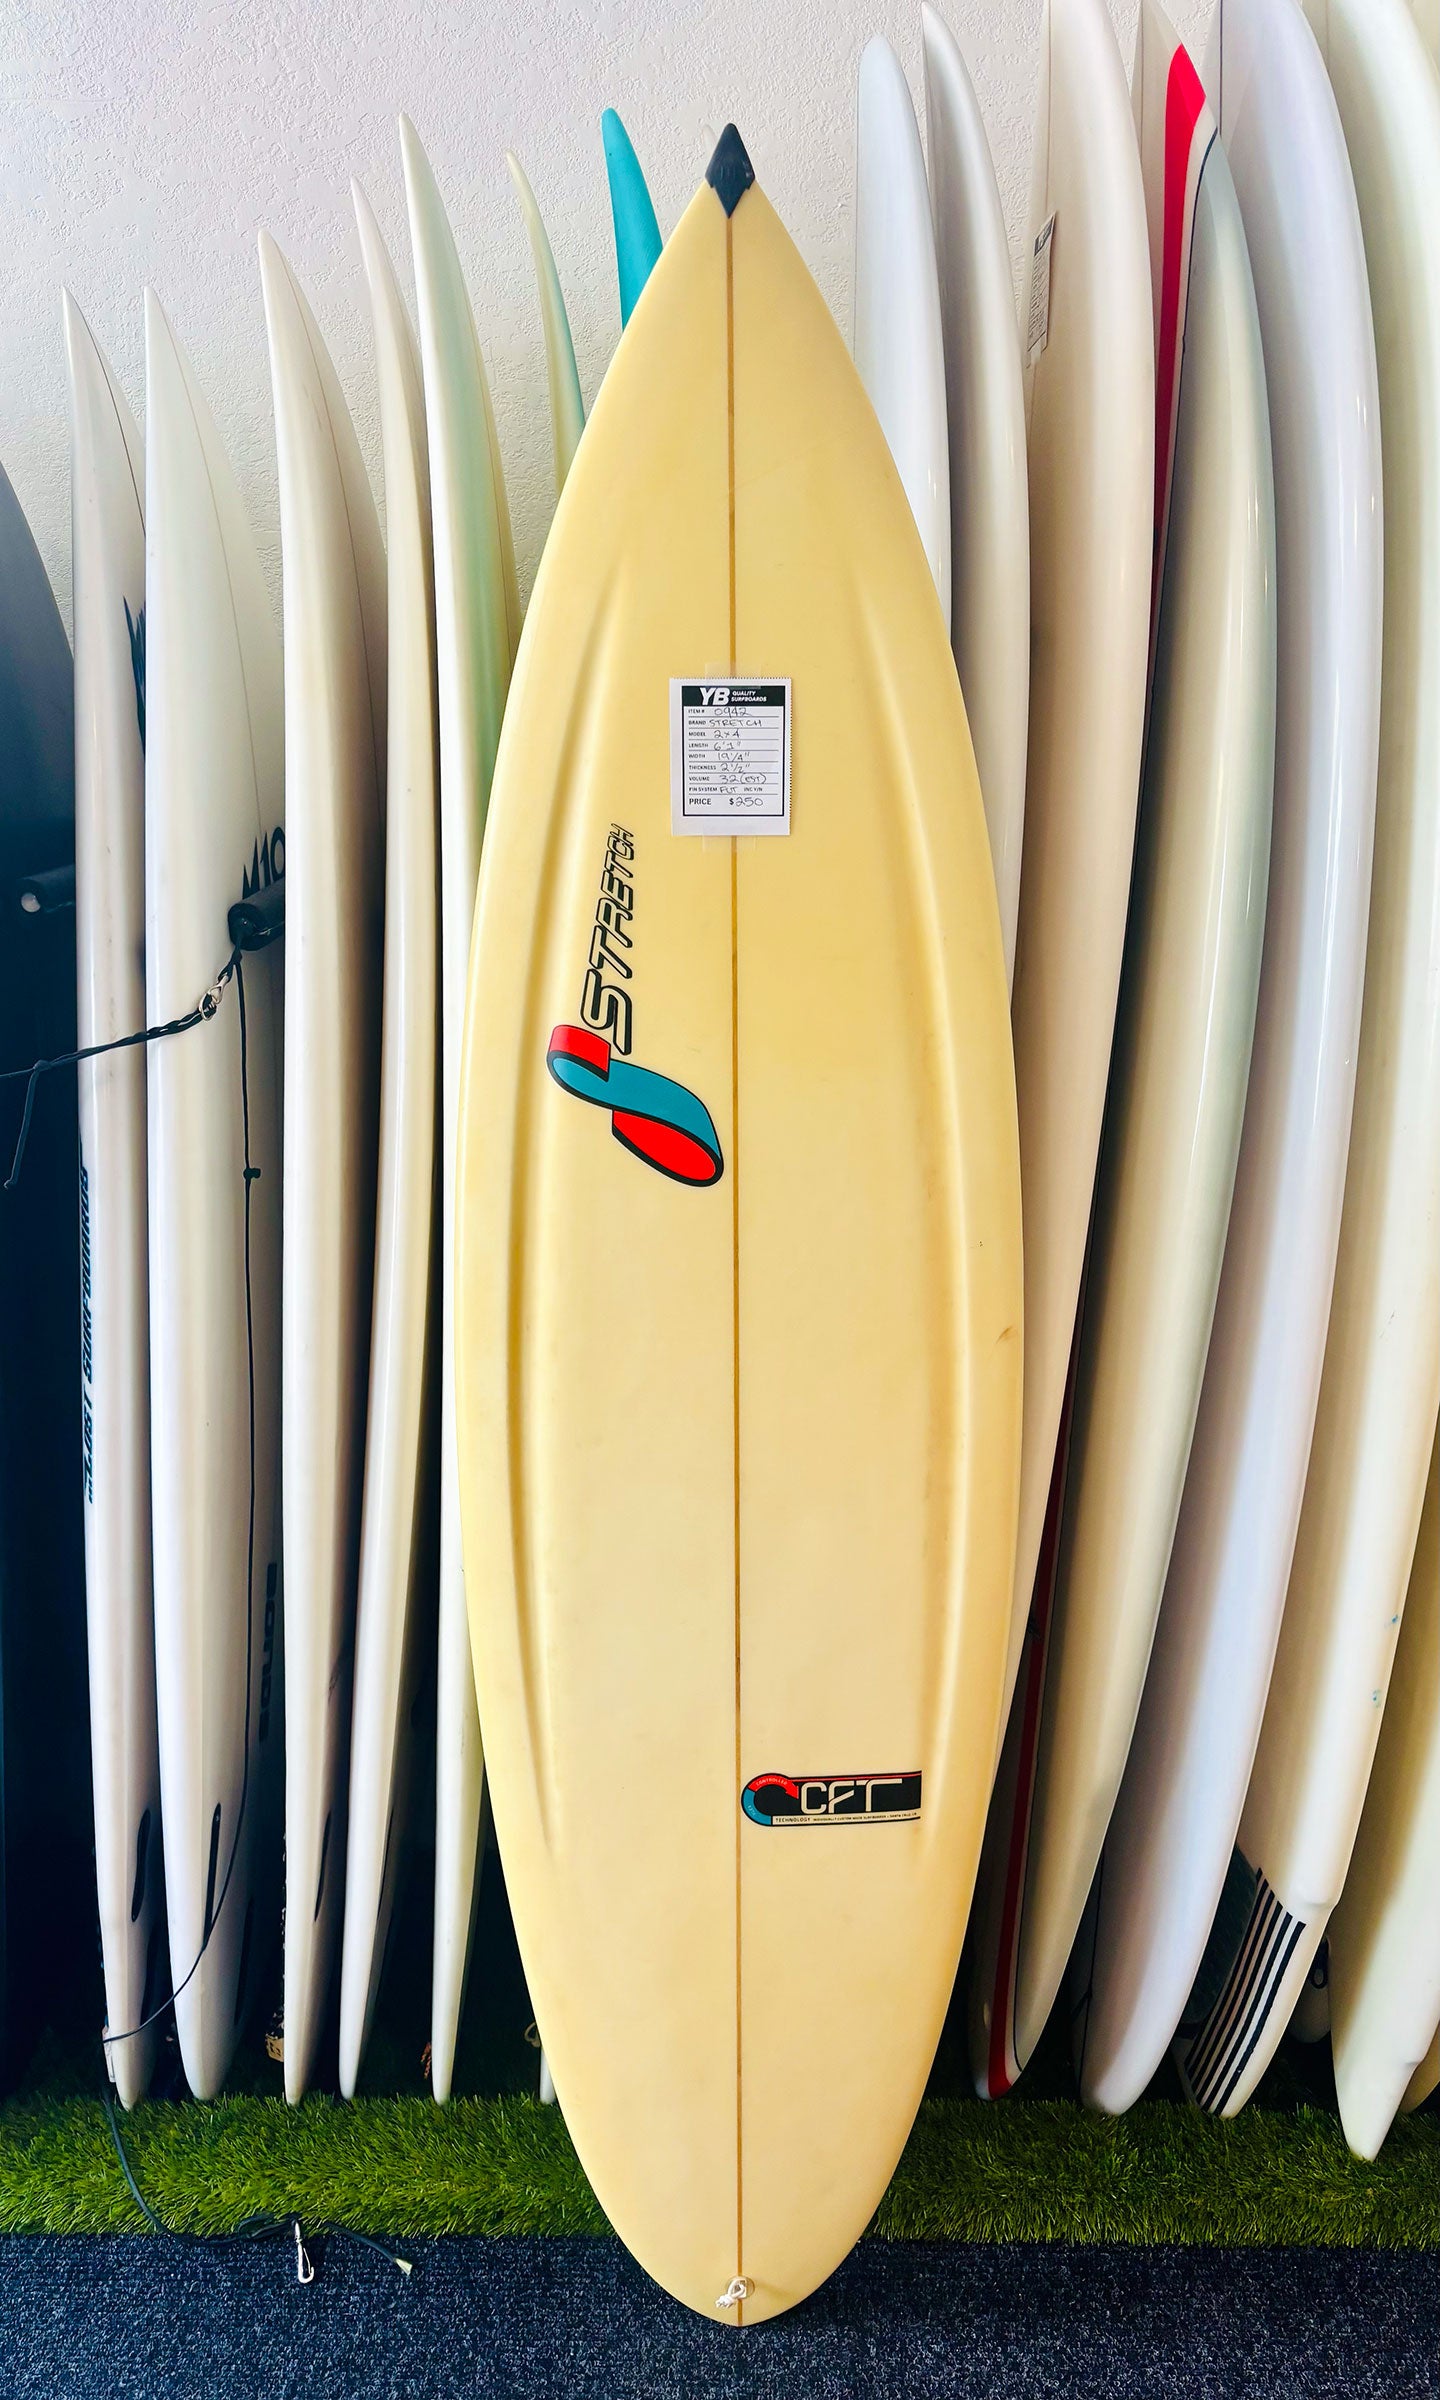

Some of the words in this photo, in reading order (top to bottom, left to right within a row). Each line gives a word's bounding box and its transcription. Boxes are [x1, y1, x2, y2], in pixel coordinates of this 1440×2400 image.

[700, 687, 731, 705] YB
[709, 719, 762, 727] STRETCH
[714, 706, 753, 718] 0942
[580, 822, 635, 1056] STRETCH
[80, 1165, 93, 1385] SURFBOARDS
[800, 1778, 903, 1815] CFT
